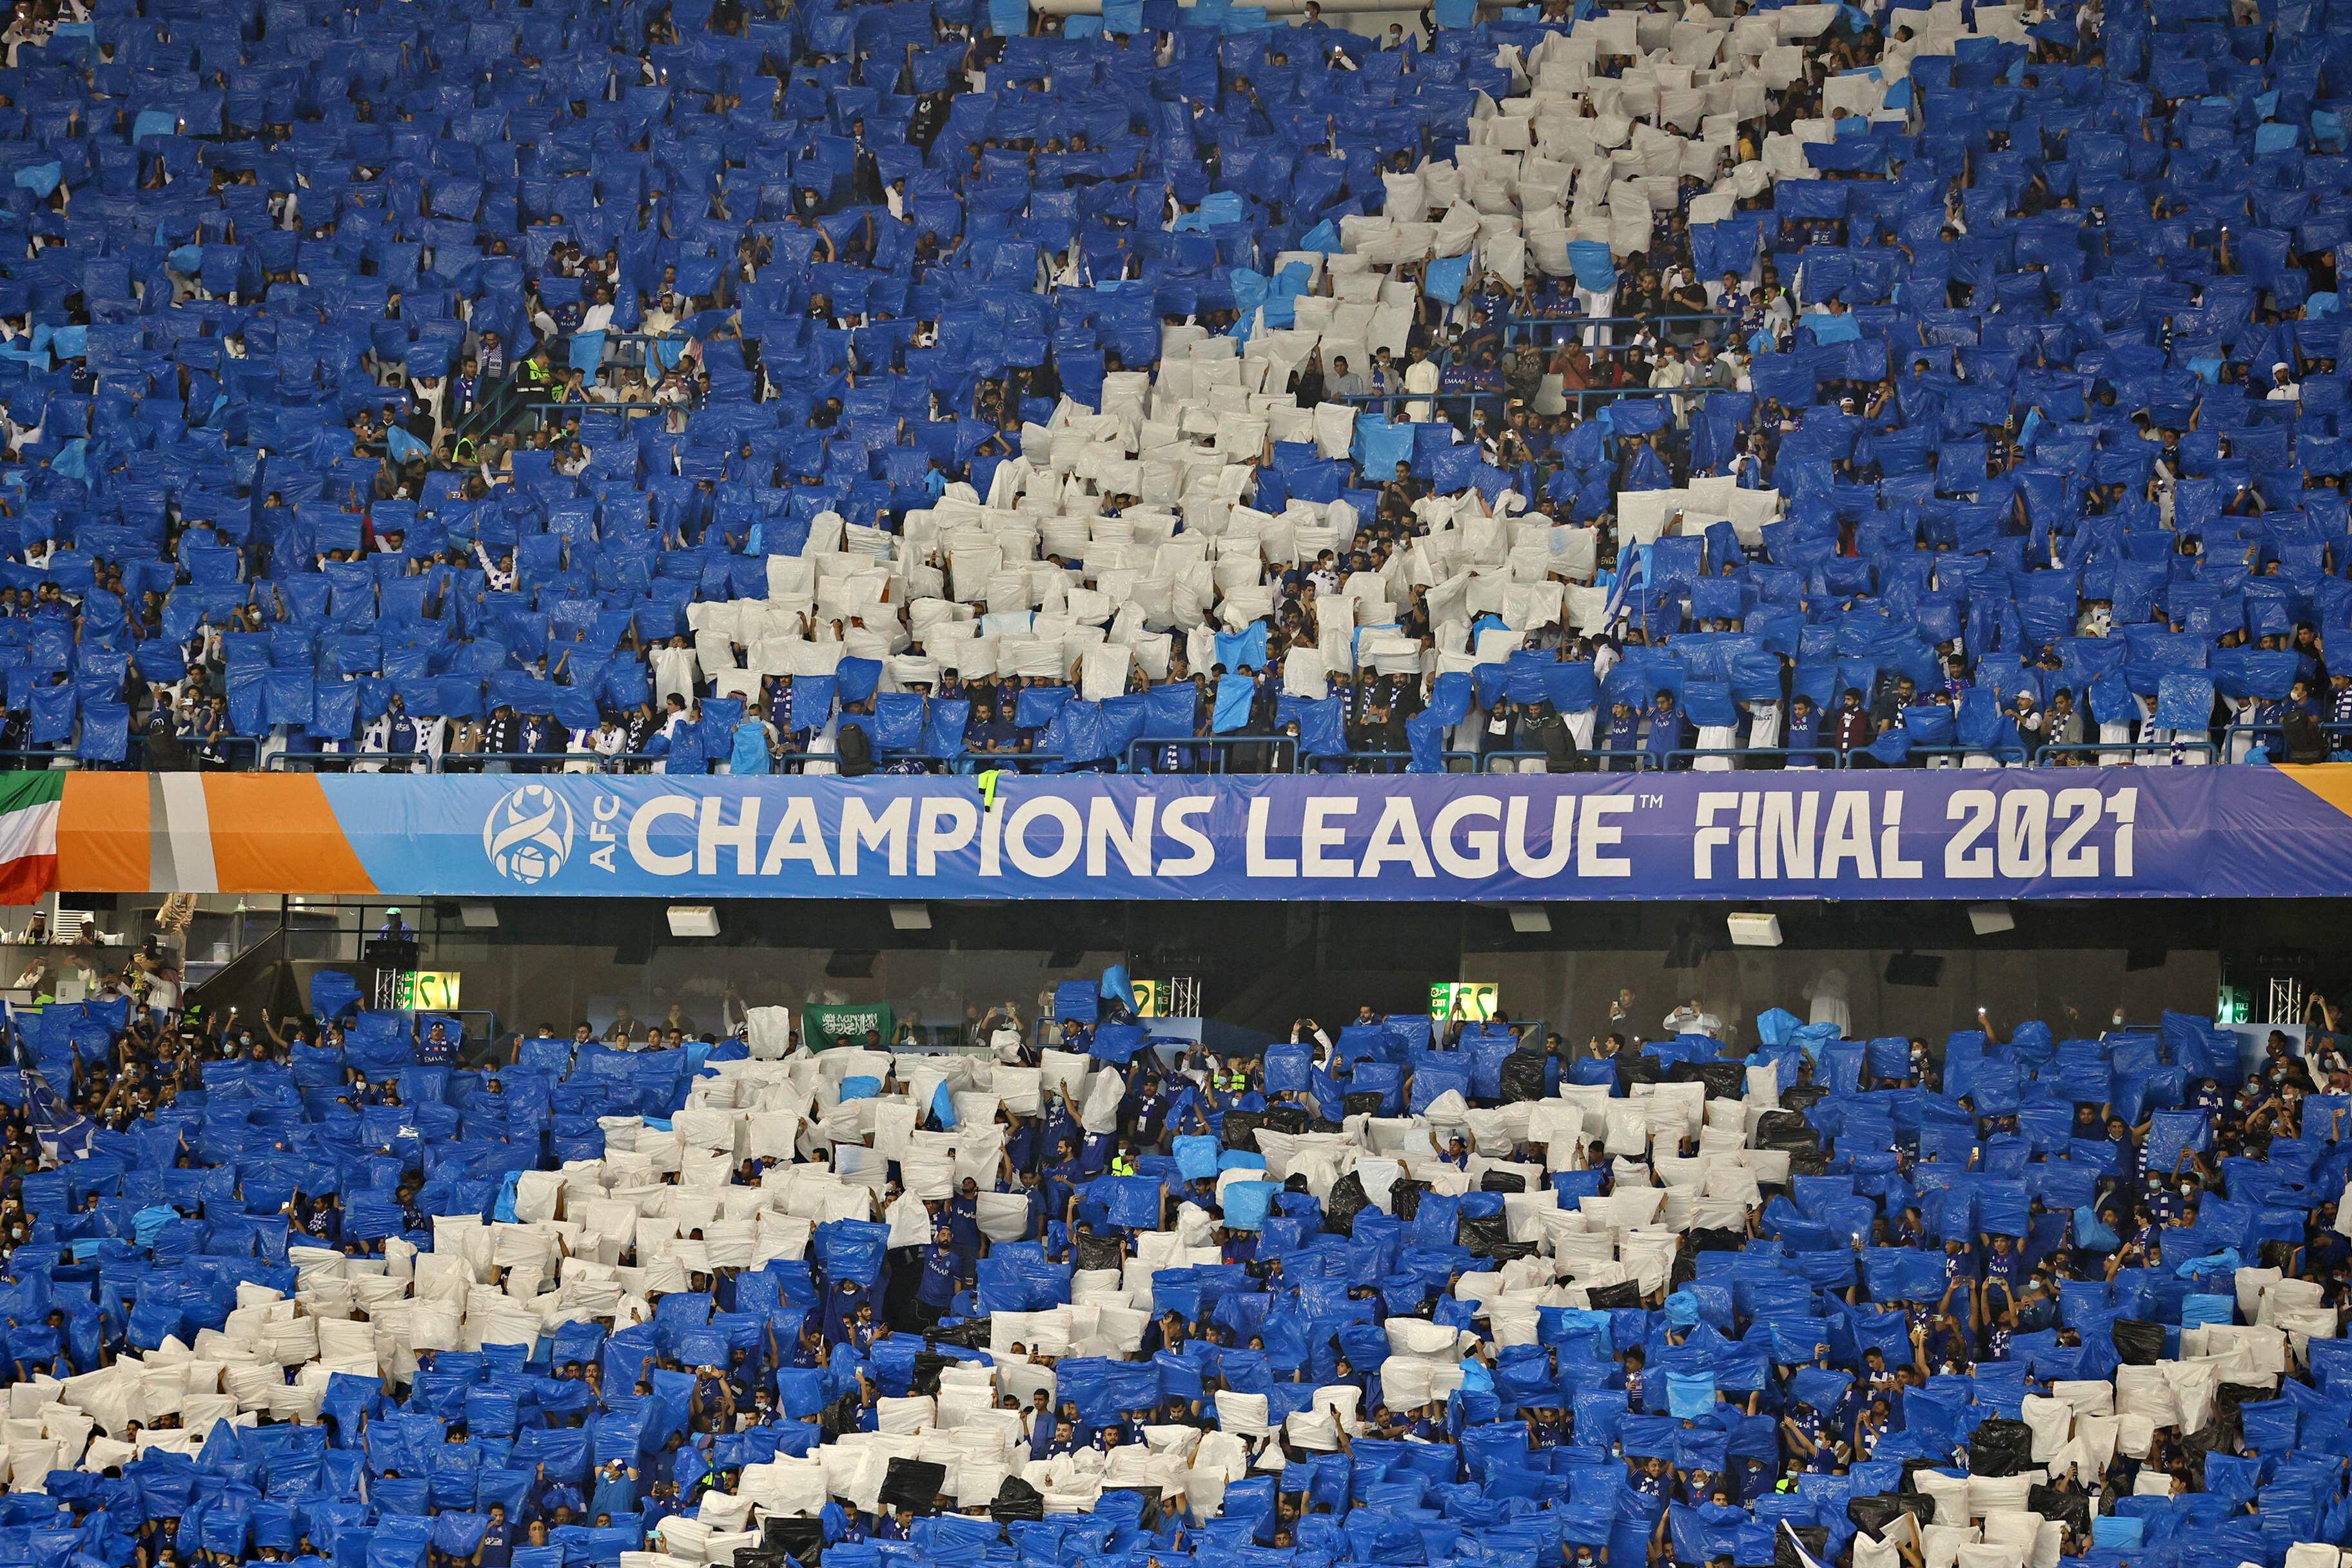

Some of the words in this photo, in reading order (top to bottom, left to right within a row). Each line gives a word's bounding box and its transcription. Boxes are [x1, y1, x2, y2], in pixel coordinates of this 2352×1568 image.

[590, 795, 620, 874] AFC
[627, 795, 1215, 877] CHAMPIONS
[1247, 793, 1634, 879] LEAGUE
[1695, 790, 1923, 879] FINAL
[1945, 787, 2138, 879] 2021
[1432, 999, 1447, 1007] EXIT
[928, 1260, 949, 1276] EMAAR
